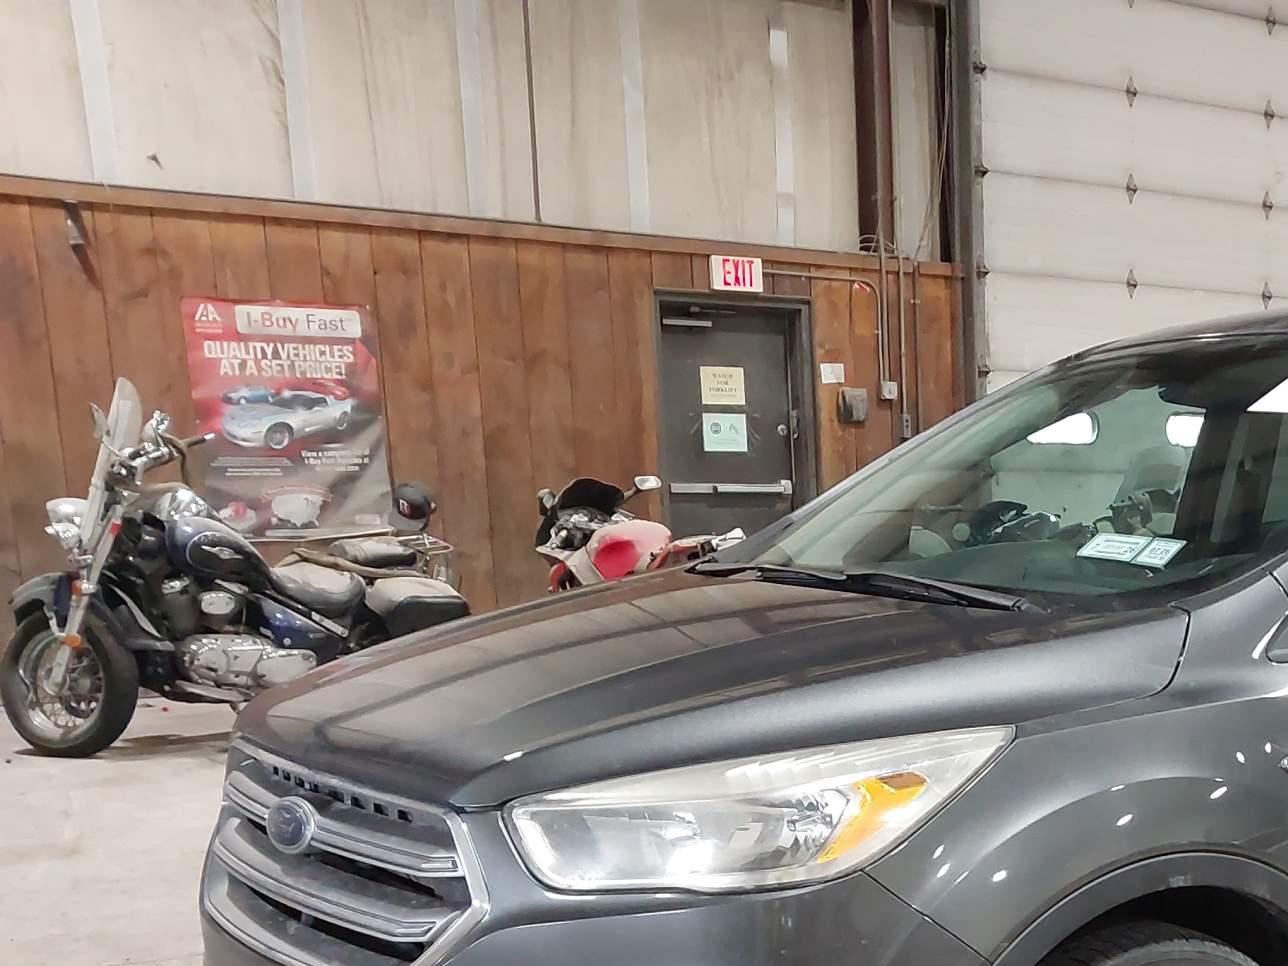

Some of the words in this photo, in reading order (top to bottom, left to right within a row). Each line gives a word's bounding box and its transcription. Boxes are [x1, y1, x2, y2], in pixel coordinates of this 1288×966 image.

[722, 259, 754, 287] EXIT
[246, 311, 299, 333] I-Buy
[306, 313, 347, 332] Fast
[203, 340, 274, 360] QUALITY
[277, 342, 354, 363] VEHICLES
[219, 359, 241, 376] AT
[245, 359, 258, 377] A
[260, 360, 291, 378] SET
[294, 361, 346, 379] PRICE!
